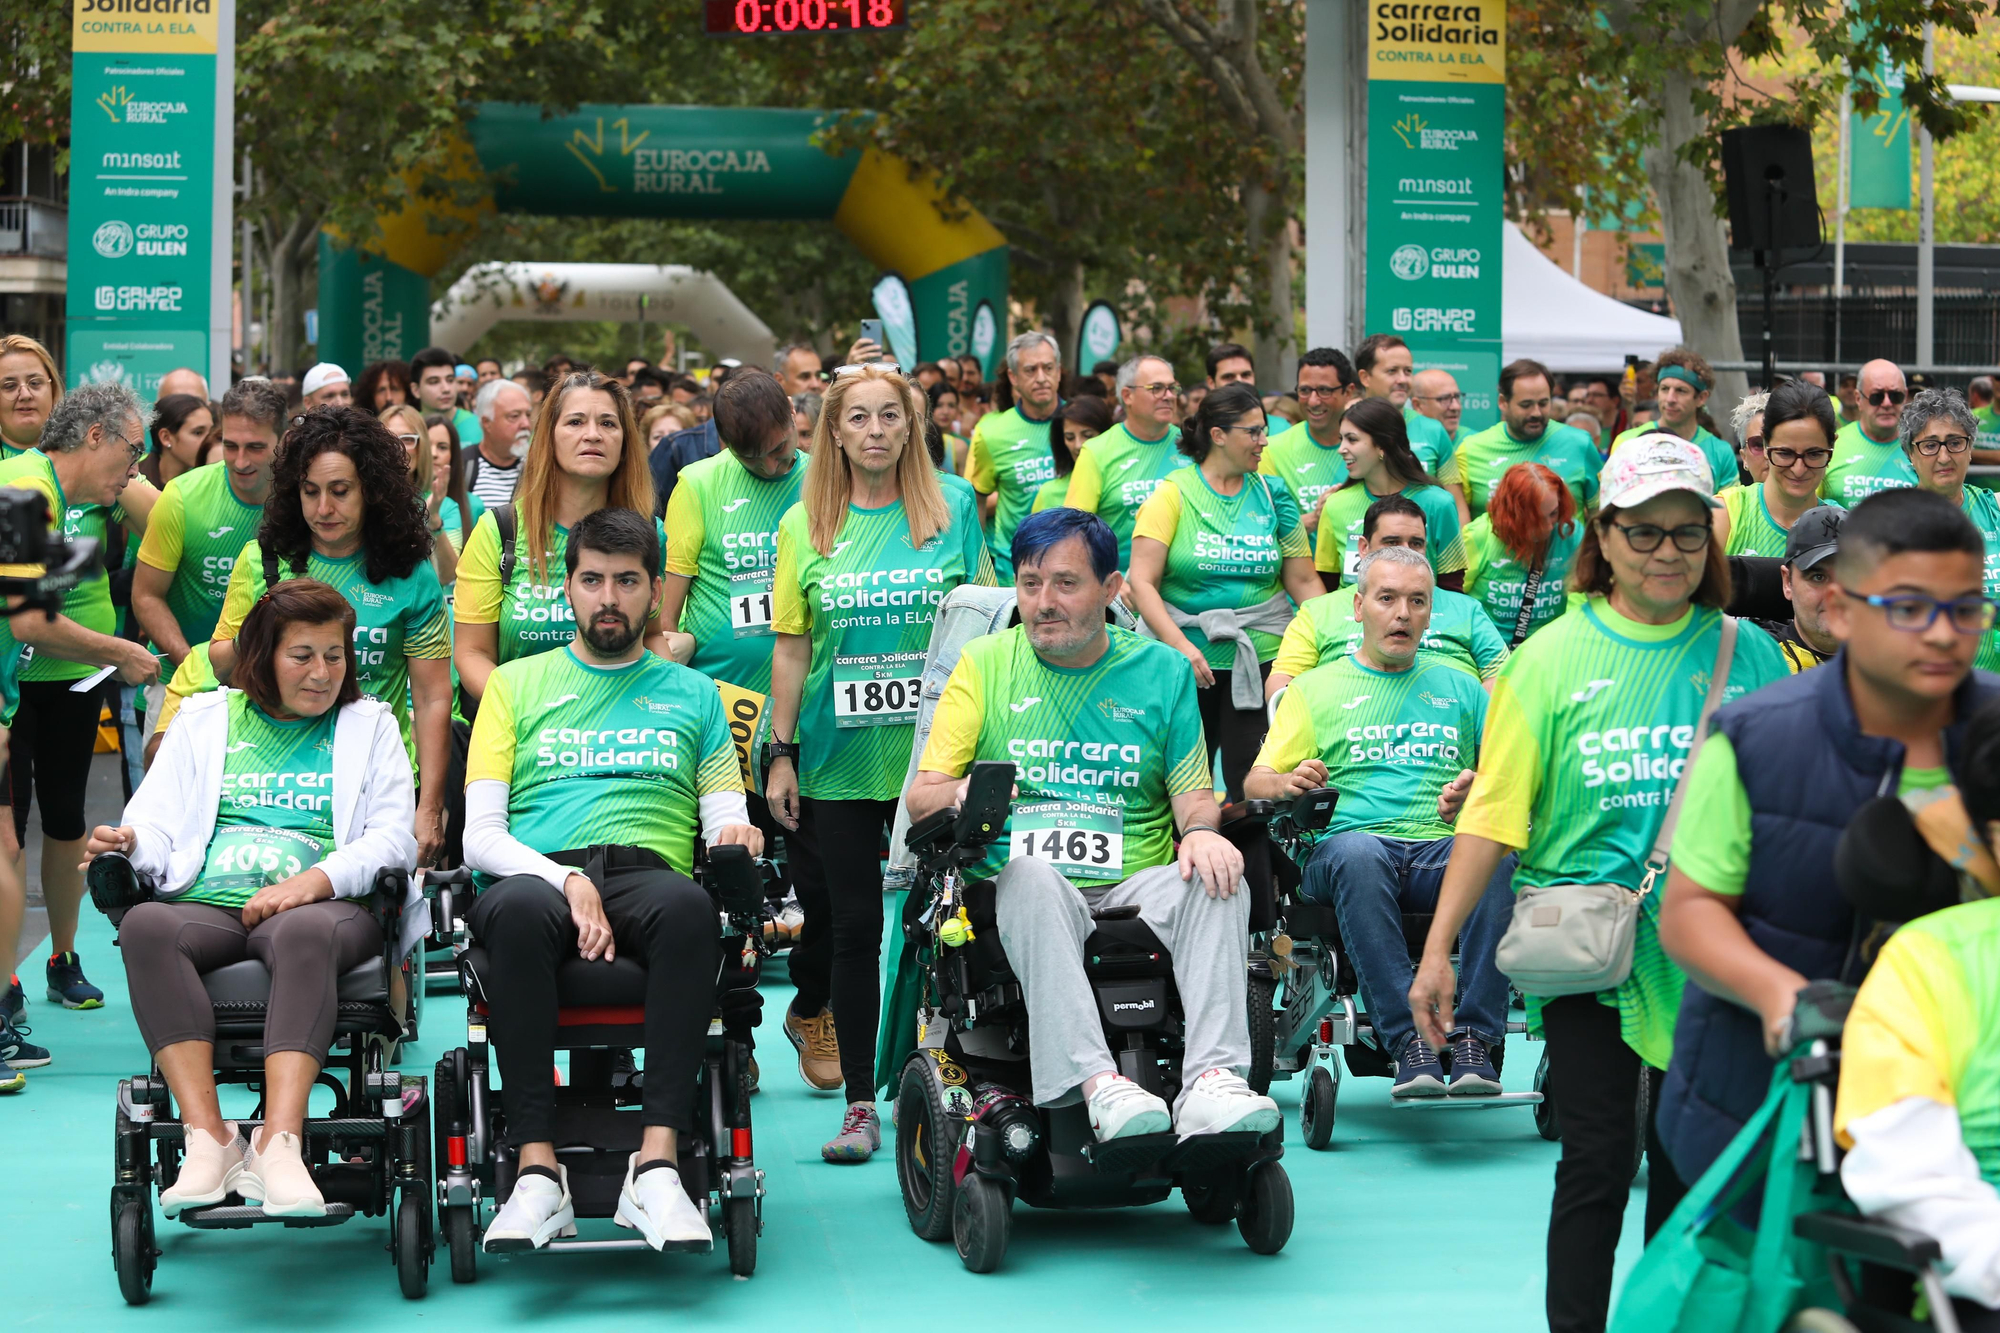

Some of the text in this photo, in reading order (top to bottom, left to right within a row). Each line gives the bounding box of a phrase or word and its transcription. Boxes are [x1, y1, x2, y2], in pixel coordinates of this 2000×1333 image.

[735, 0, 893, 32] 0:00:18
[1377, 3, 1481, 22] carrera
[82, 22, 196, 34] CONTRA LA ELA
[1376, 22, 1498, 45] Solidaria
[1376, 50, 1485, 64] CONTRA LA ELA
[127, 102, 188, 113] EUROCAJA
[126, 113, 167, 123] RURAL
[1421, 129, 1478, 141] EUROCAJA
[634, 150, 771, 172] EUROCAJA
[634, 173, 723, 193] RURAL
[118, 187, 139, 196] Indra
[140, 189, 179, 198] company
[136, 224, 189, 239] GRUPO
[136, 241, 187, 256] EULEN
[1431, 247, 1481, 263] GRUPO
[1431, 264, 1479, 279] EULEN
[117, 286, 182, 299] GRUPO
[116, 299, 182, 311] UNITEL
[1413, 308, 1475, 321] GRUPO
[1413, 319, 1475, 332] UNITEL
[1193, 543, 1279, 562] Solidaria
[731, 570, 768, 582] carrera
[1198, 563, 1275, 575] contra la ELA
[820, 568, 944, 589] carrera
[820, 586, 944, 612] Solidaria
[739, 594, 772, 624] 11
[831, 611, 934, 629] contra la ELA
[519, 629, 576, 641] contra
[836, 655, 877, 664] carrera
[844, 679, 922, 712] 1803
[1113, 707, 1145, 715] EUROCAJA
[538, 727, 678, 748] carrera
[1346, 722, 1458, 741] carrera
[1578, 724, 1694, 756] carre
[537, 746, 678, 770] Solidaria
[1007, 738, 1140, 763] carrera
[1349, 740, 1459, 763] Solidaria
[221, 772, 333, 788] carrer
[1095, 793, 1127, 806] ELA
[1017, 802, 1119, 817] carrera Solidaria
[1057, 819, 1076, 827] 5KM
[1022, 831, 1110, 864] 1463
[214, 844, 302, 884] 4053
[1113, 1000, 1154, 1011] permobil
